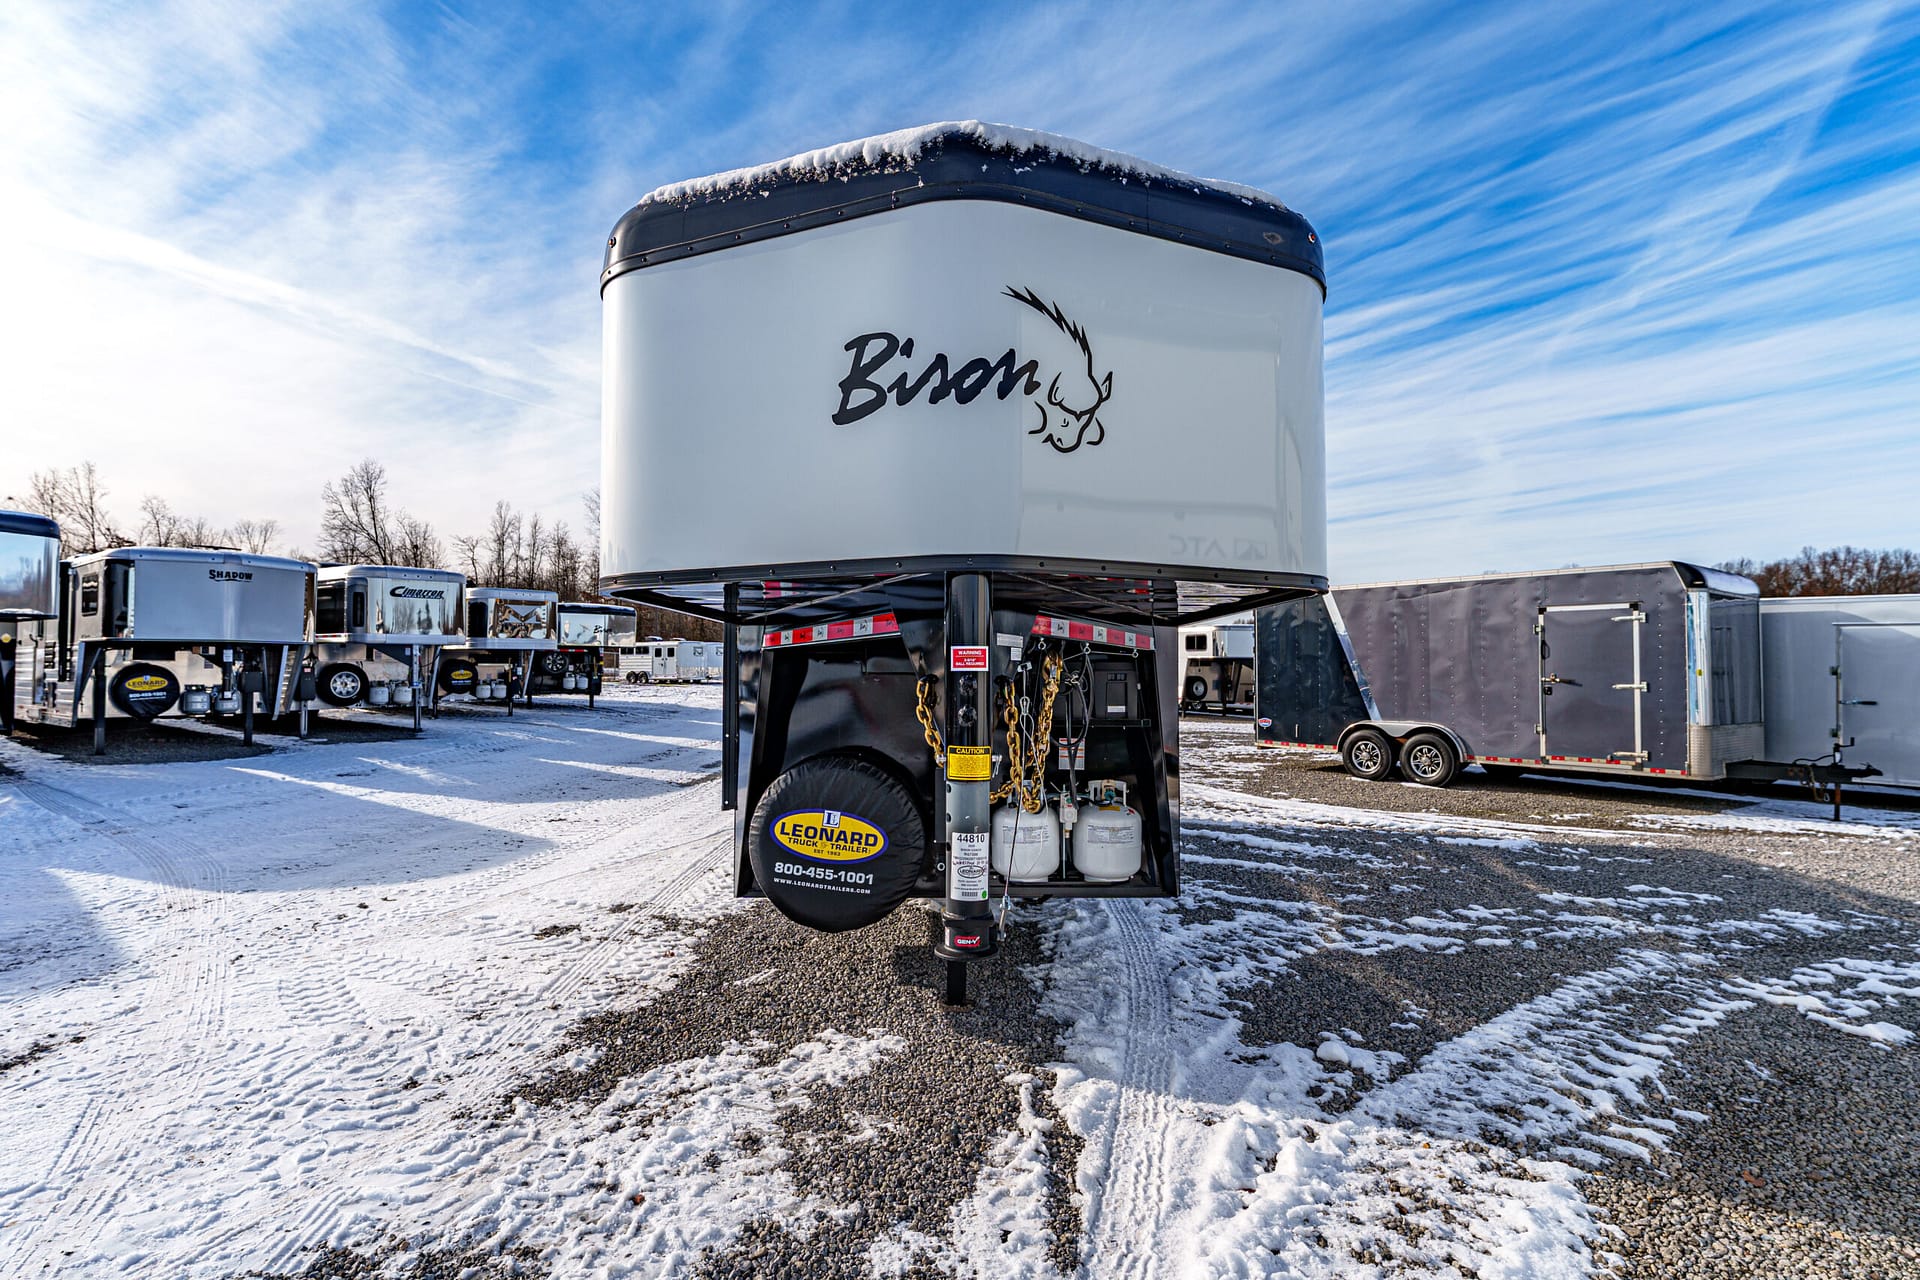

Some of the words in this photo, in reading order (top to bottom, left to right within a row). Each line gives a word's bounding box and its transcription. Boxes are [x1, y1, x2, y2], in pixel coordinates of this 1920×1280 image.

[832, 332, 1041, 426] Bison
[209, 569, 253, 580] SHADOW
[390, 586, 445, 600] Cimarron
[780, 822, 879, 847] LEONARD
[956, 834, 985, 843] 44810
[788, 837, 818, 848] TRUCK
[830, 842, 868, 854] TRAILER
[774, 862, 874, 885] 800-455-1001
[773, 877, 871, 895] WWW.LEONARDTRAILERS.COM
